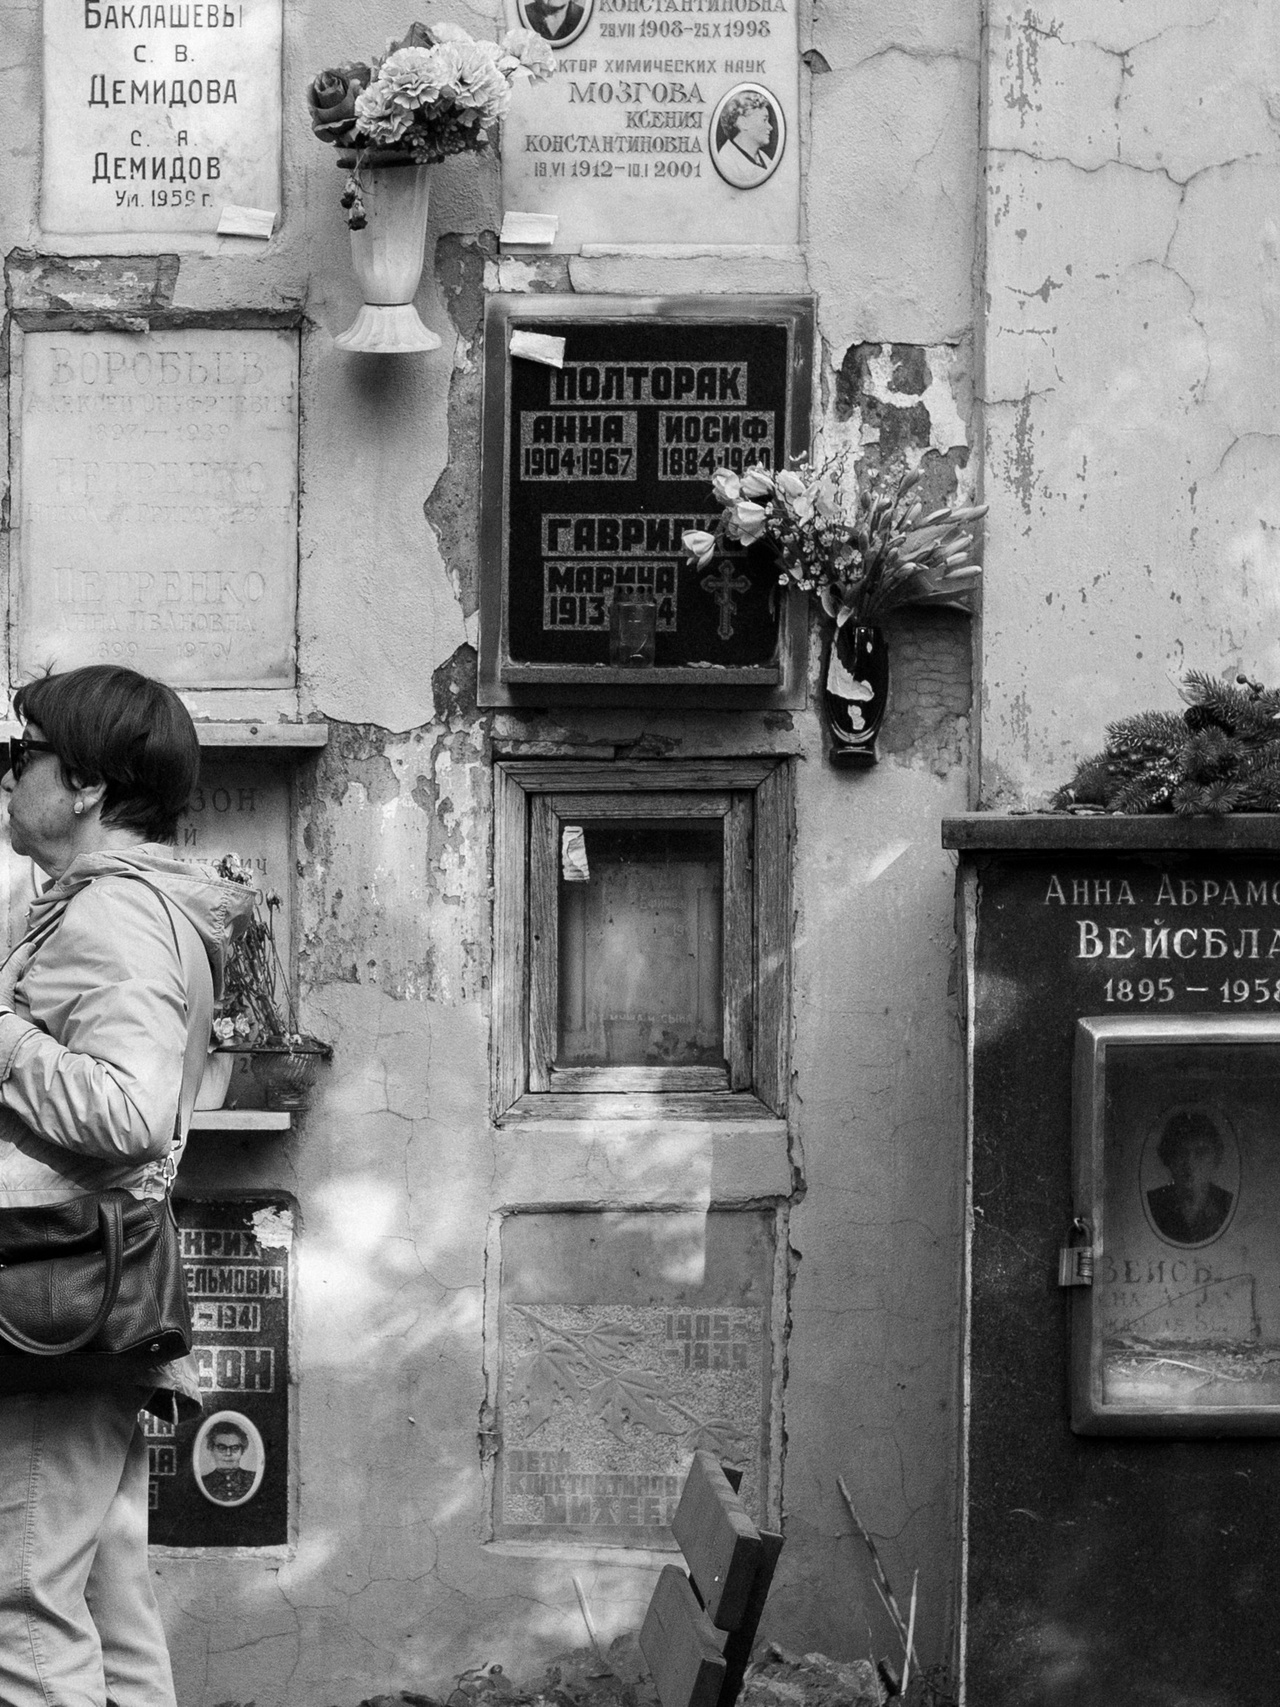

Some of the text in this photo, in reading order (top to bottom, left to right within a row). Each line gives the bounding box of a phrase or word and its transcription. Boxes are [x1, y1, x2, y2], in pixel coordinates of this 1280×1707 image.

[85, 0, 242, 28] БАКЛАШЕВЫ
[724, 20, 771, 37] 1998
[554, 59, 766, 74] КТОР ХИМИЧЕСКИХ НАУК
[569, 82, 706, 104] МОЗГОВА
[625, 111, 703, 129] КСЕНИЯ
[524, 134, 704, 154] КОНСТАНТИНОВНА
[654, 160, 702, 178] 2001
[557, 366, 741, 401] ПОЛТОРАК
[533, 415, 769, 443] АННА ИОСИФ
[52, 567, 266, 605] ПЕТРЕНКО
[1043, 874, 1136, 906] АННА
[1104, 978, 1175, 1003] 1895
[186, 1268, 282, 1294] ЕЛЬМОВИЧ
